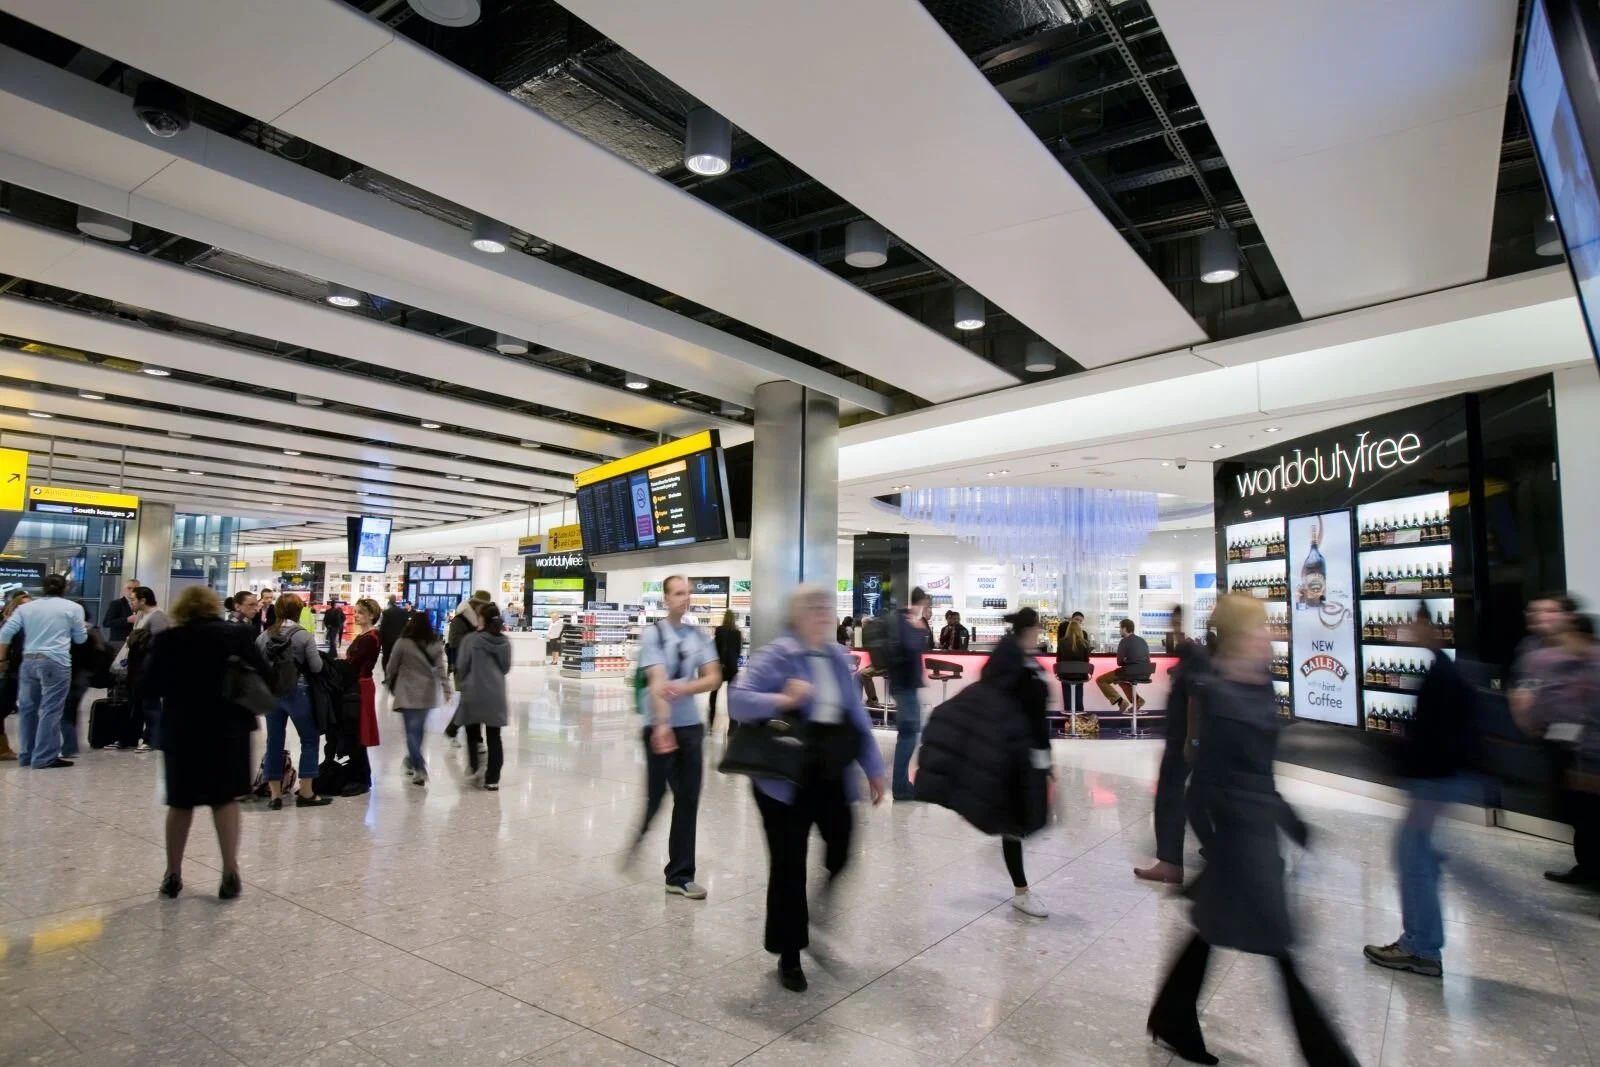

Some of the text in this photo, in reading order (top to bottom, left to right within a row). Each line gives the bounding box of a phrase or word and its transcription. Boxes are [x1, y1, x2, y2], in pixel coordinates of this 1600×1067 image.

[1236, 431, 1421, 498] worlddutyfree
[73, 506, 96, 515] South
[97, 508, 125, 517] lounges
[535, 554, 584, 570] worlddutyfree
[696, 583, 720, 591] Cigarettes
[1312, 640, 1334, 652] NEW
[1302, 656, 1345, 677] BAILEYS
[1321, 681, 1336, 692] hint
[1308, 691, 1343, 709] Coffee
